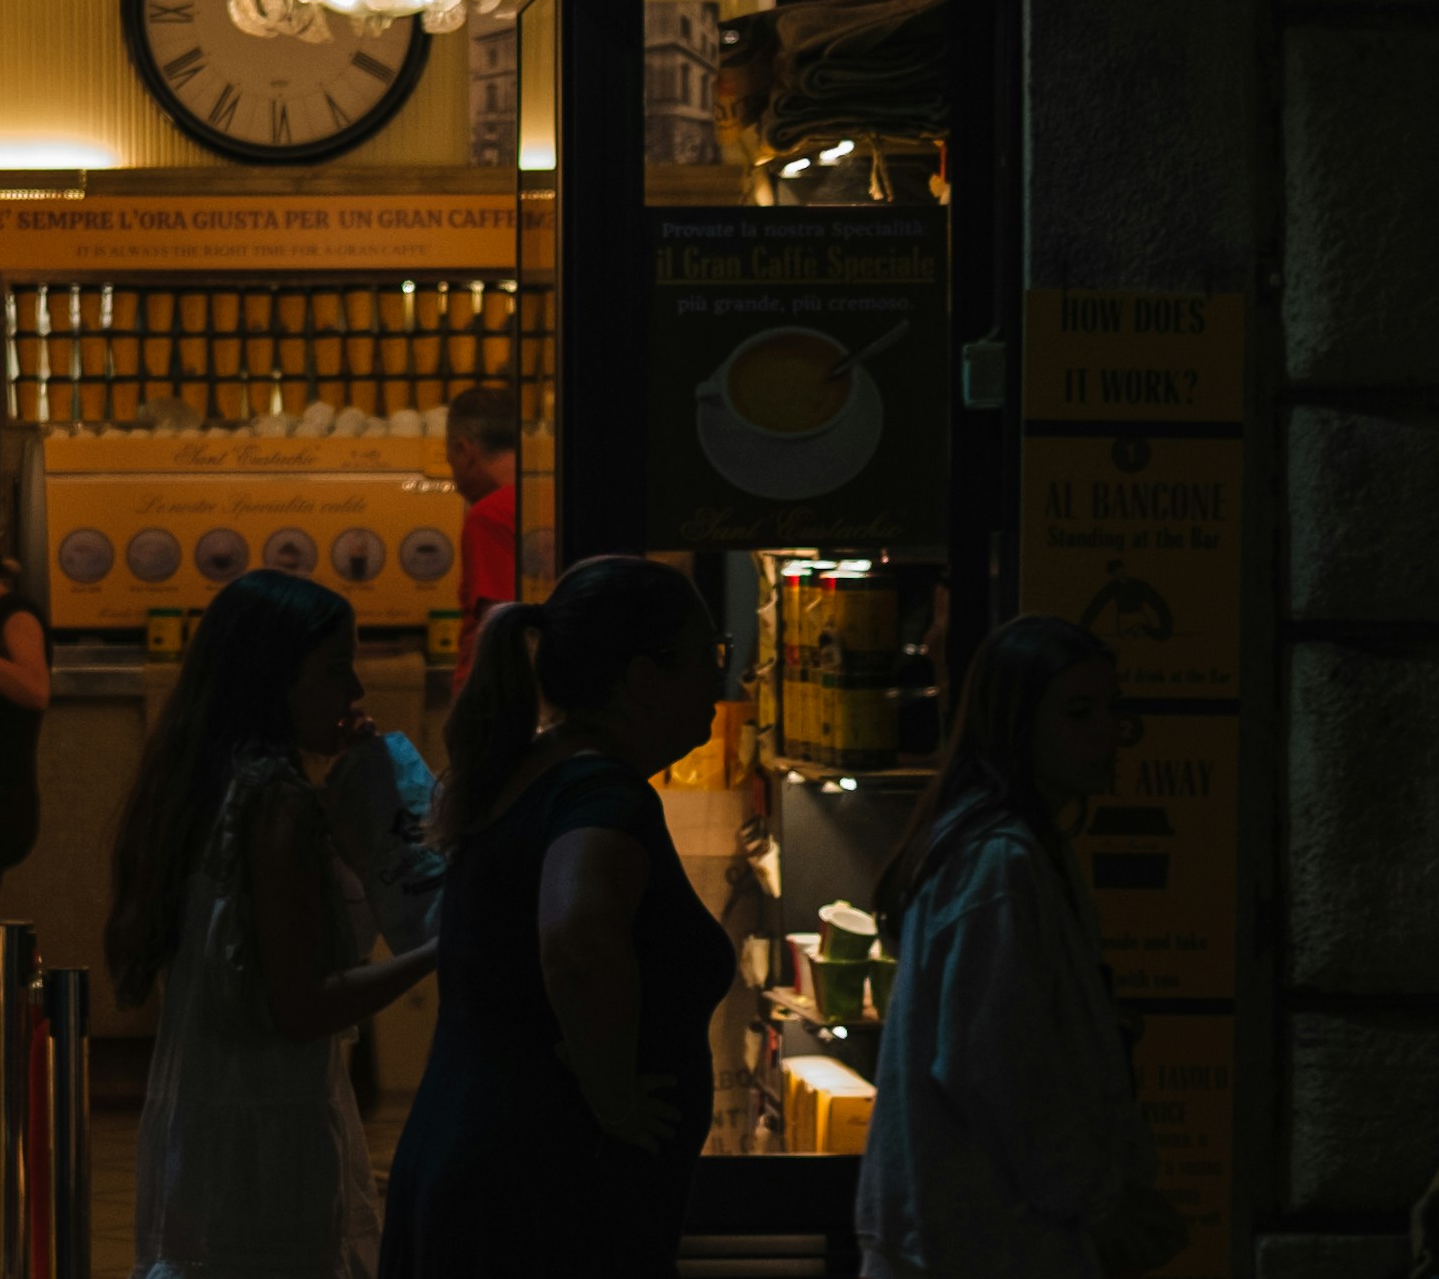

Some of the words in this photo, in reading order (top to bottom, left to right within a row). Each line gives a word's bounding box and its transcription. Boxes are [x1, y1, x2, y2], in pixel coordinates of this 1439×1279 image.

[17, 209, 115, 231] SEMPRE
[119, 208, 187, 231] L'ORA
[192, 210, 279, 231] GIUSTA
[284, 209, 328, 231] PER
[339, 209, 373, 230] UN
[378, 209, 444, 230] GRAN
[662, 221, 735, 238] Provate
[741, 220, 758, 238] la
[764, 222, 826, 237] nostra
[109, 245, 169, 258] ALWAYS
[173, 245, 199, 258] THE
[204, 244, 249, 258] RIGHT
[682, 245, 742, 278] Gran
[752, 244, 819, 278] Caffè
[826, 244, 935, 284] Speciale
[677, 295, 708, 316] più
[713, 295, 785, 316] grande,
[791, 295, 822, 315] più
[827, 298, 915, 313] cremoso.
[1061, 296, 1123, 334] HOW
[1134, 298, 1206, 334] DOES
[1065, 369, 1089, 404] IT
[1100, 369, 1199, 405] WORK?
[167, 499, 217, 515] nostre
[1044, 482, 1078, 520] AL
[1092, 482, 1228, 522] BANCONE
[1046, 524, 1125, 551] Standing
[1133, 530, 1148, 549] at
[1155, 527, 1185, 549] the
[1191, 525, 1220, 550] Bar
[1120, 720, 1134, 740] 2
[1136, 759, 1214, 798] AWAY
